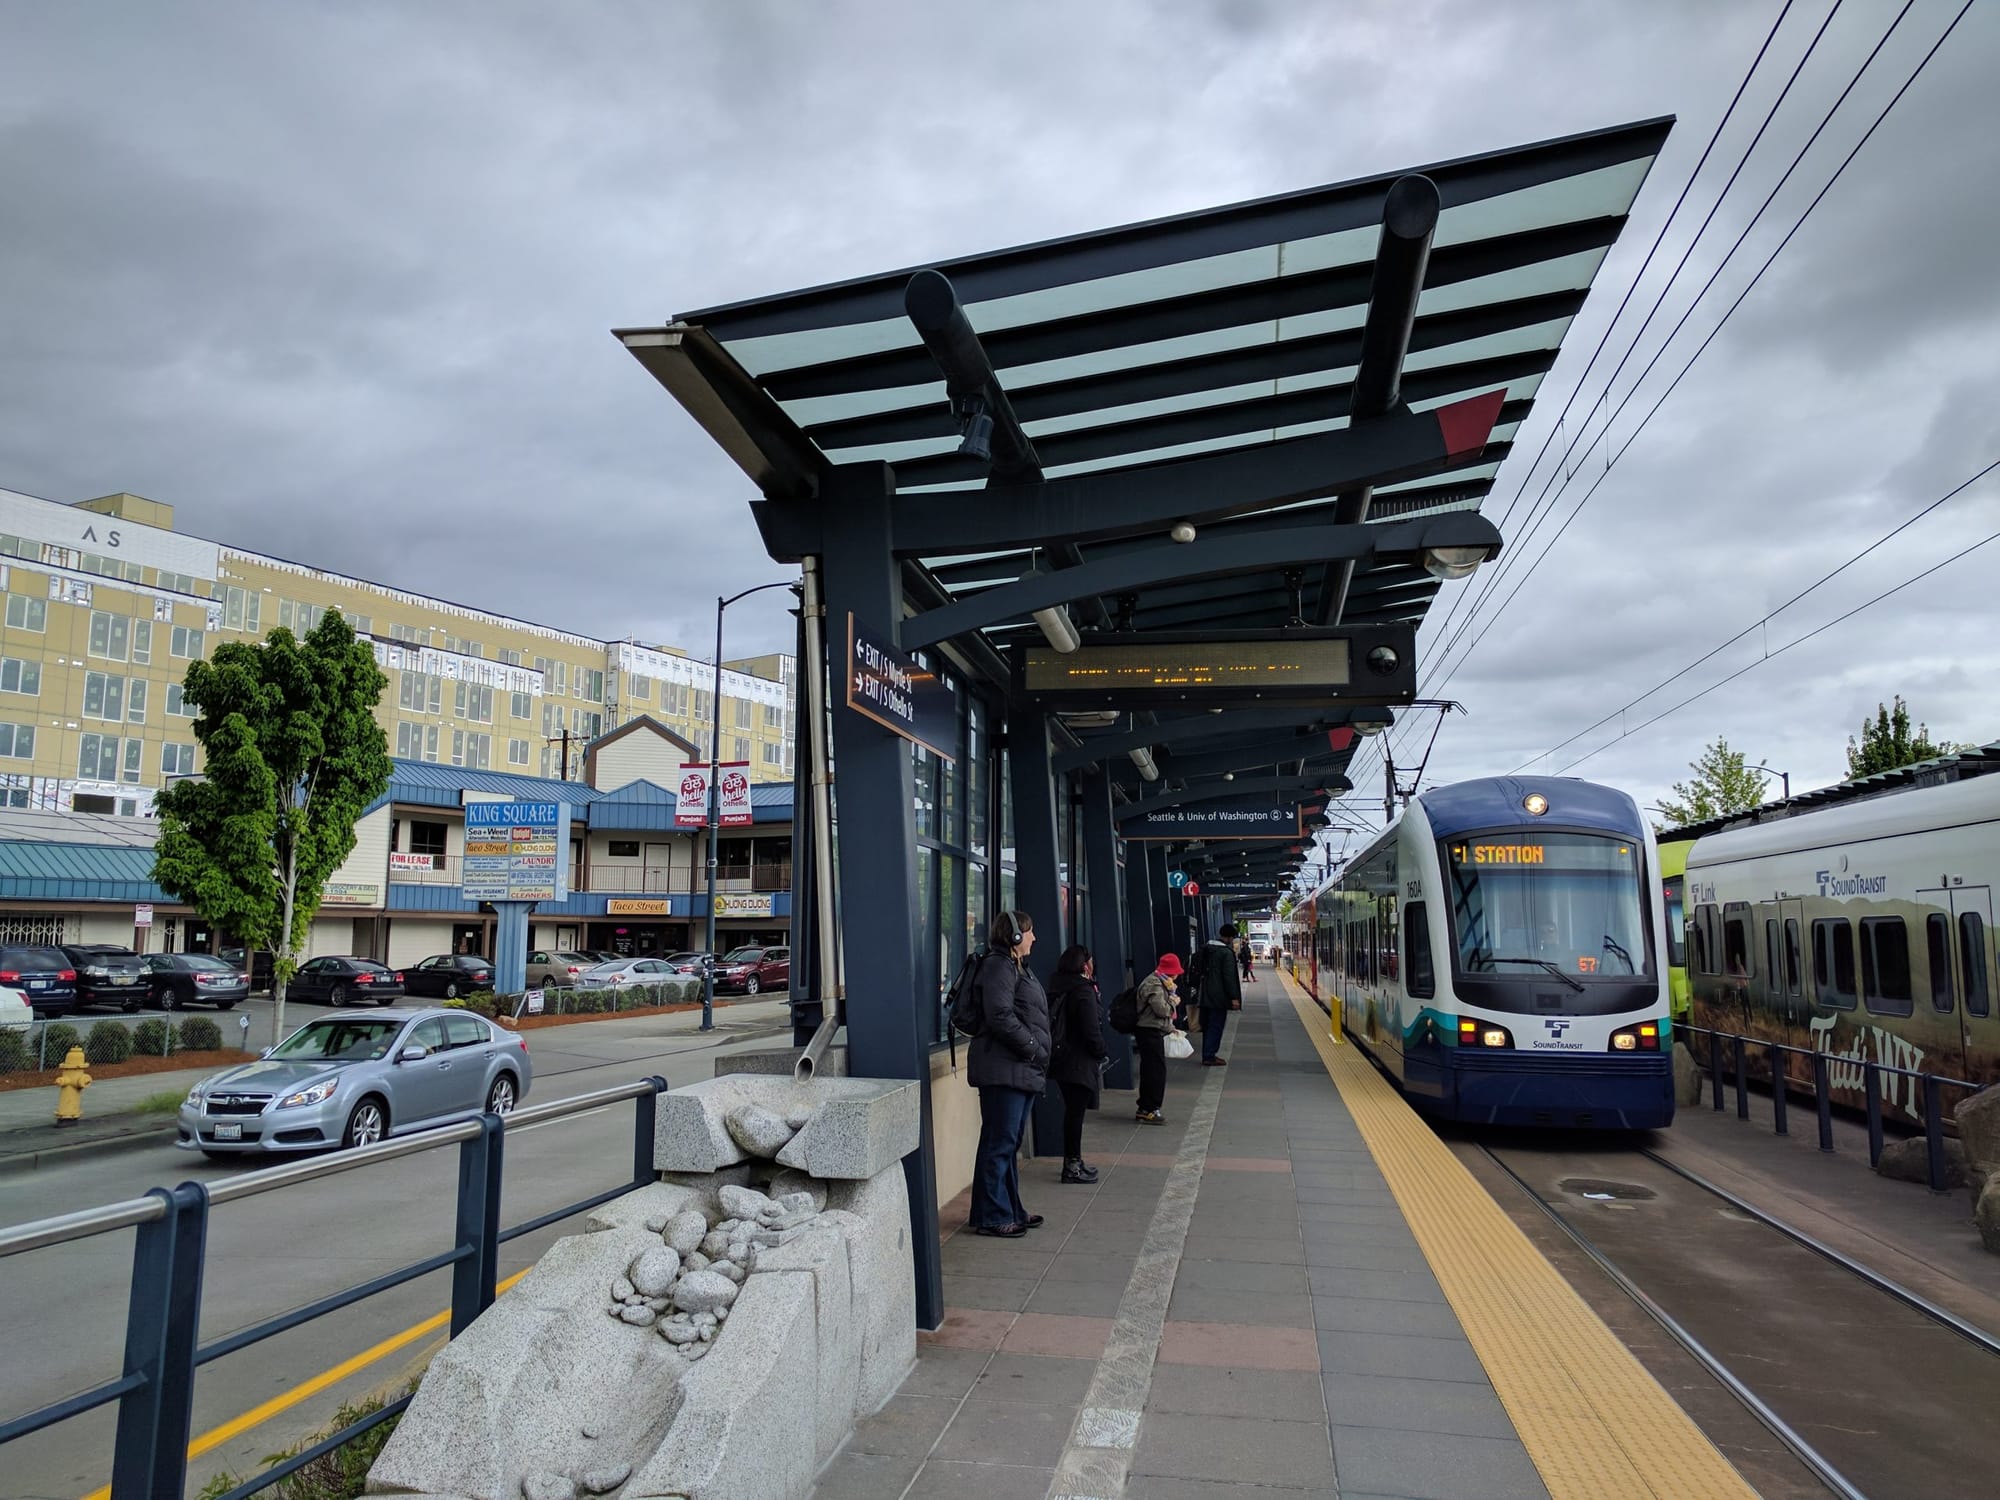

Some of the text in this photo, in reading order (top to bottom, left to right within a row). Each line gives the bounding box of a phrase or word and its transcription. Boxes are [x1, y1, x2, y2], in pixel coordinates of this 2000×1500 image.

[866, 643, 879, 671] EXIT
[884, 656, 888, 677] S
[889, 660, 906, 689] Myrtle
[906, 673, 912, 694] St
[866, 674, 879, 700] EXIT
[884, 686, 888, 706] S
[889, 689, 907, 718] Othello
[908, 702, 913, 722] St
[684, 788, 705, 800] hello
[725, 787, 747, 800] hello
[469, 805, 555, 823] KING SQUARE
[1147, 811, 1268, 822] Seattle & Univ. of Washington
[466, 843, 508, 852] Taco Street
[1474, 846, 1543, 864] STATION
[392, 854, 431, 864] FOR LEASE
[1407, 880, 1422, 899] 160A
[1700, 881, 1716, 901] Link
[613, 901, 664, 911] Taco Street
[1871, 1025, 1925, 1120] WY
